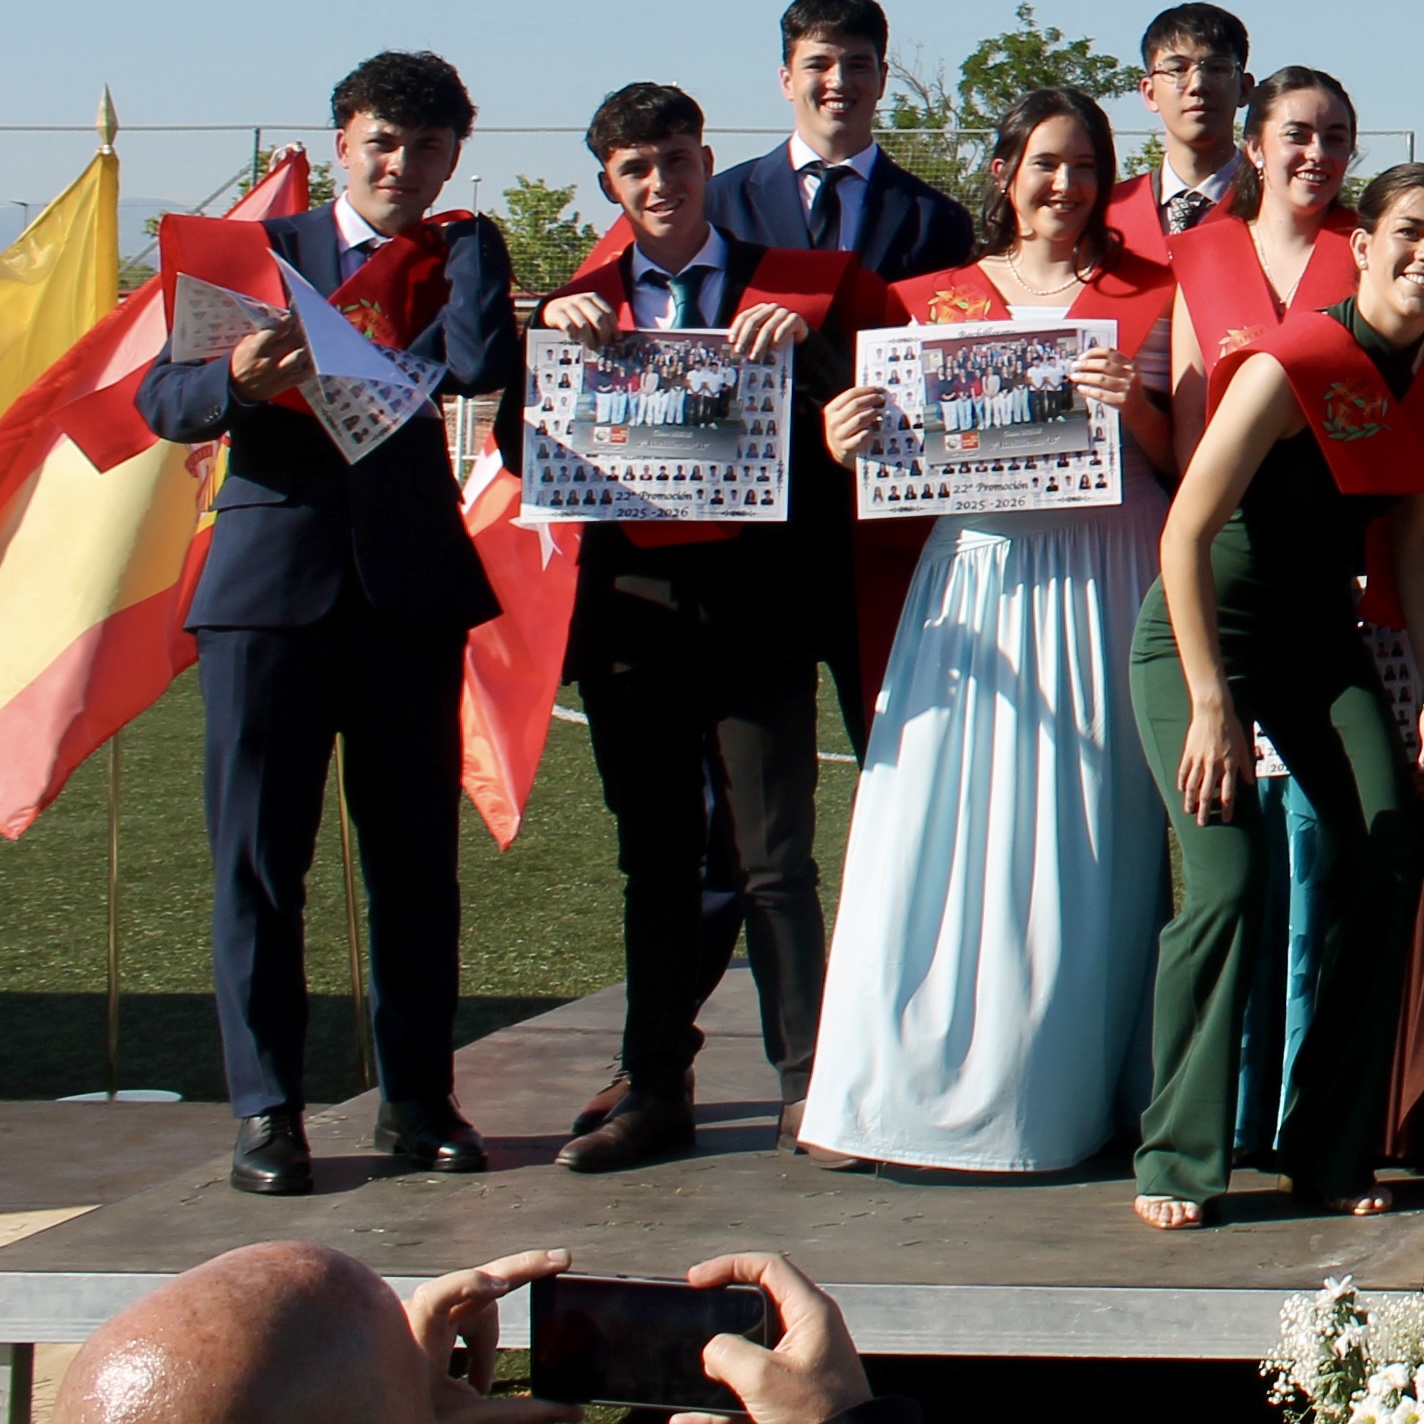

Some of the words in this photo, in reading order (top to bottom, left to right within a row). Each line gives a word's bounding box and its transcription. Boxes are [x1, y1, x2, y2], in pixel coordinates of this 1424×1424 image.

[976, 481, 1029, 493] Promoción
[640, 490, 693, 502] Promoción
[955, 500, 985, 511] 2025
[617, 508, 646, 518] 2025
